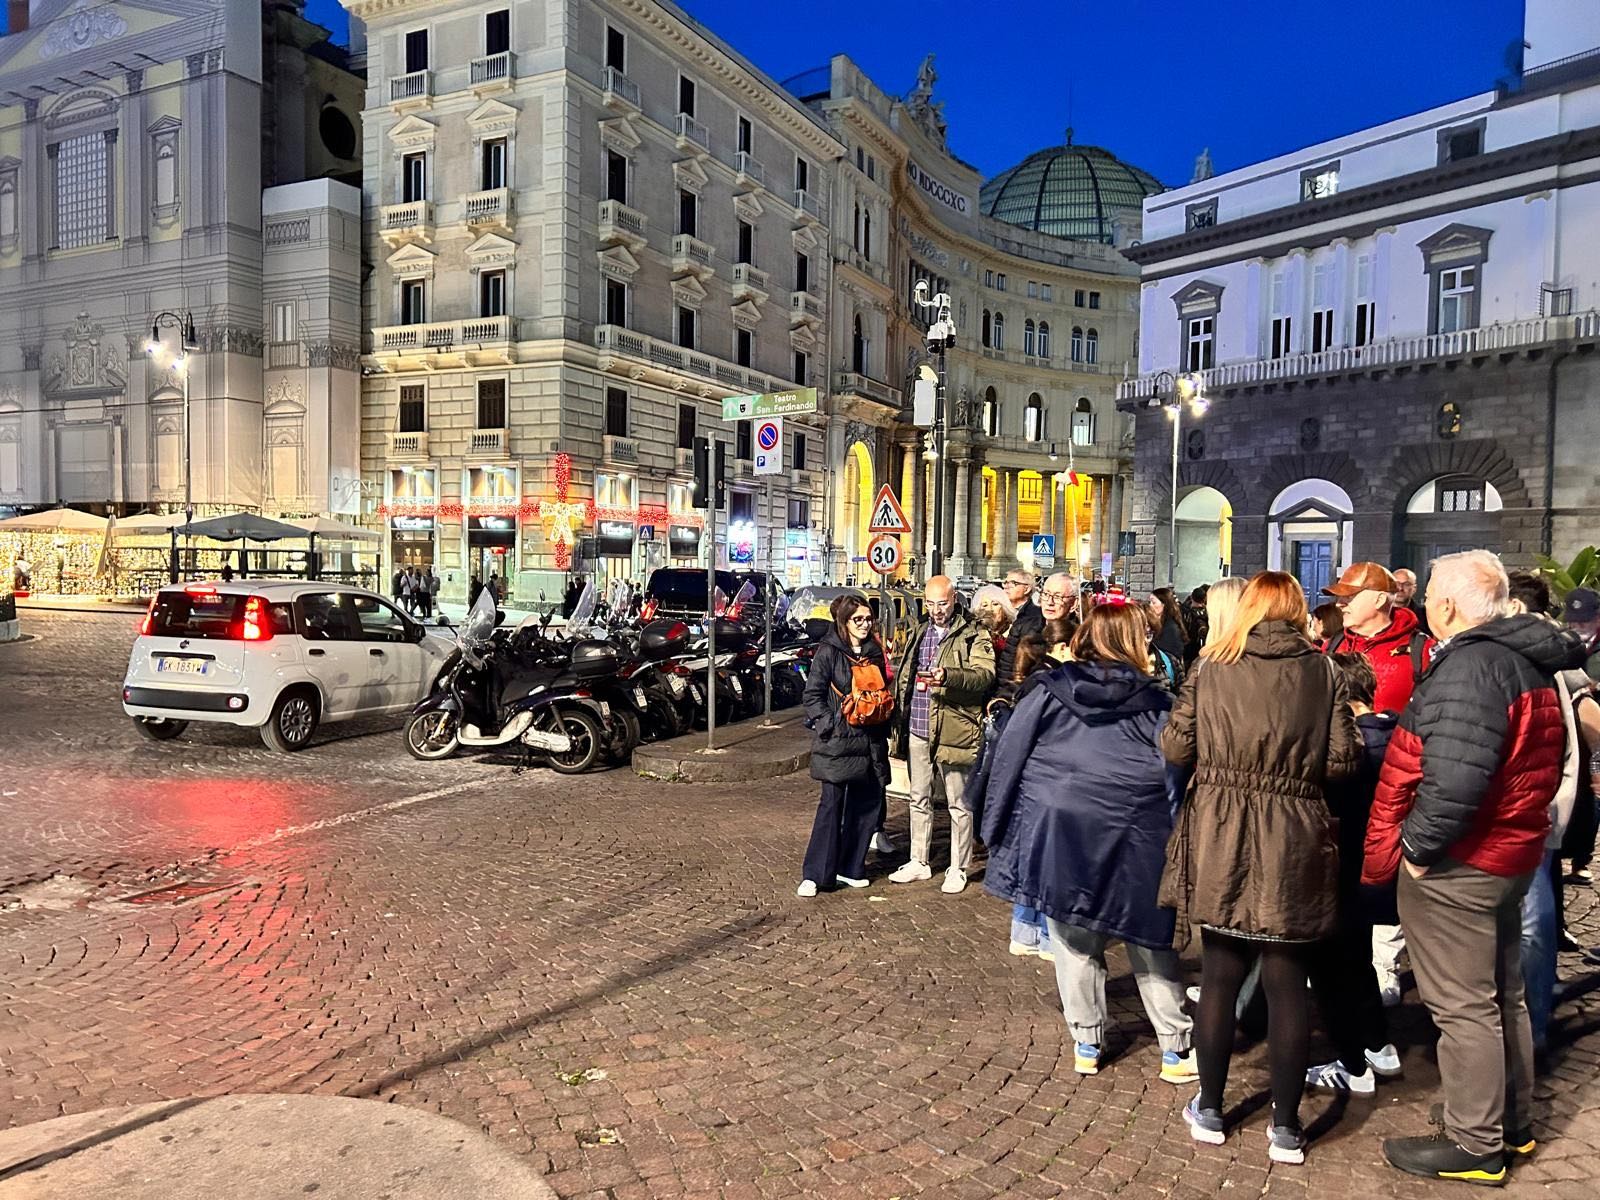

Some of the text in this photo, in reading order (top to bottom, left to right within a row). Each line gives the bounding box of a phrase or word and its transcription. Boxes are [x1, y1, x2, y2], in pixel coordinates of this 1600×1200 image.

[919, 170, 966, 212] MDCCCXC
[773, 394, 797, 403] Teatro
[756, 401, 814, 414] San Ferdinando
[873, 546, 895, 564] 30
